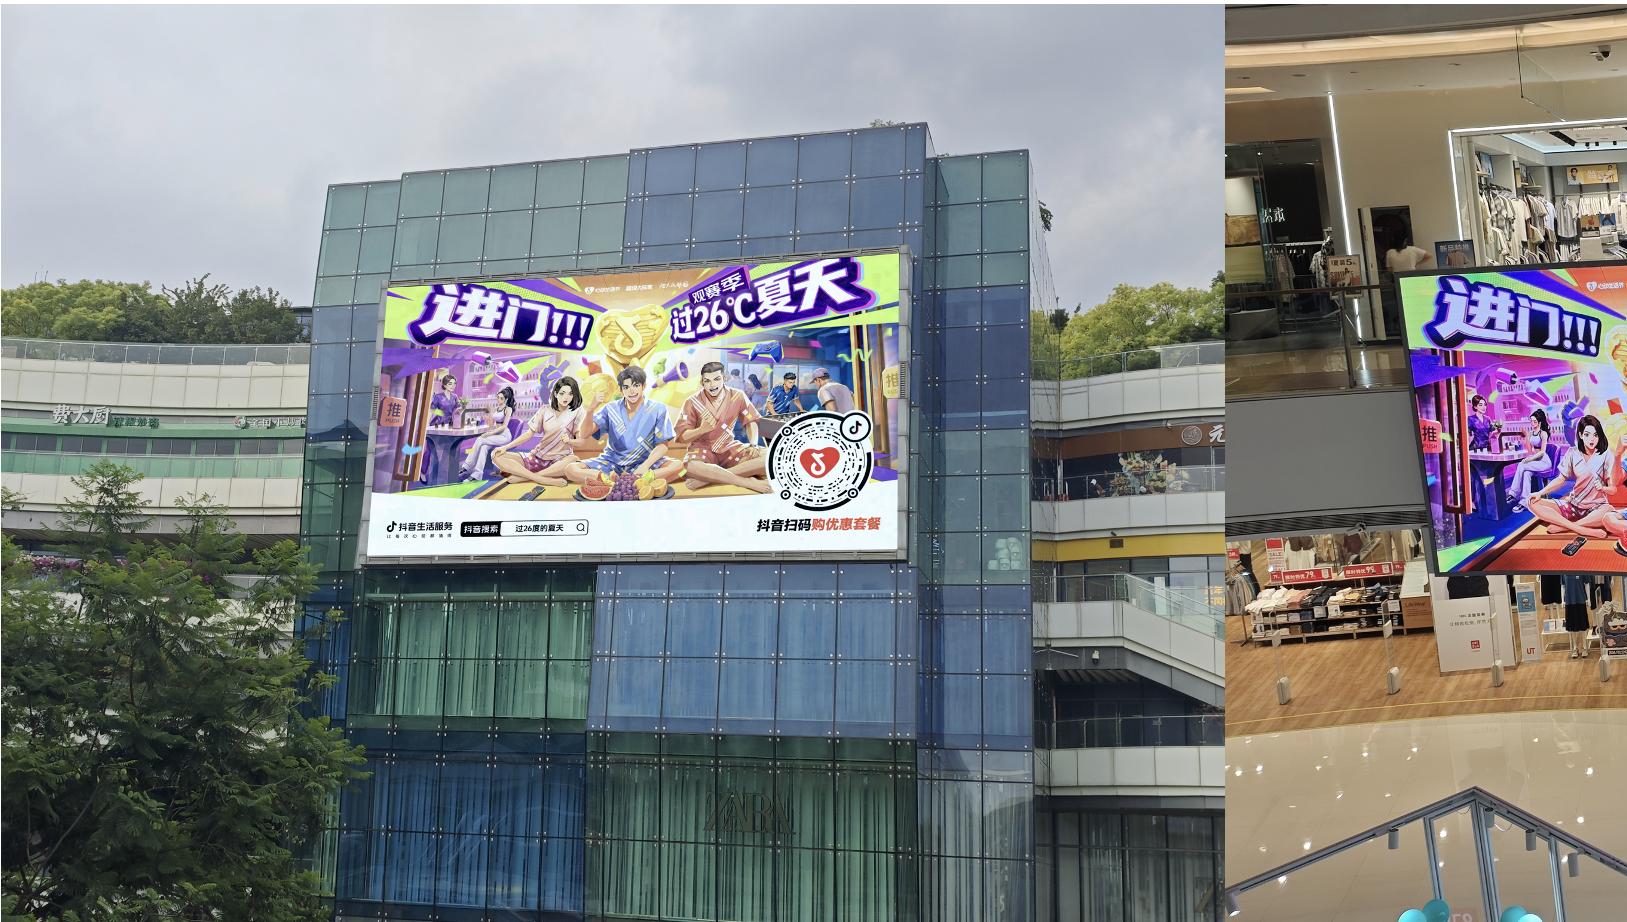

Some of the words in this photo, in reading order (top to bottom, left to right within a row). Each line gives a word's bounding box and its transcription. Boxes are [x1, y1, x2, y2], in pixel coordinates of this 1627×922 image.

[692, 272, 745, 304] 观赛季
[52, 404, 112, 425] 费大厨
[388, 402, 402, 417] 推
[1422, 425, 1437, 442] 推
[398, 522, 453, 532] 抖音生活服务
[463, 525, 499, 534] 抖音搜索
[515, 523, 564, 533] 过26度的夏天
